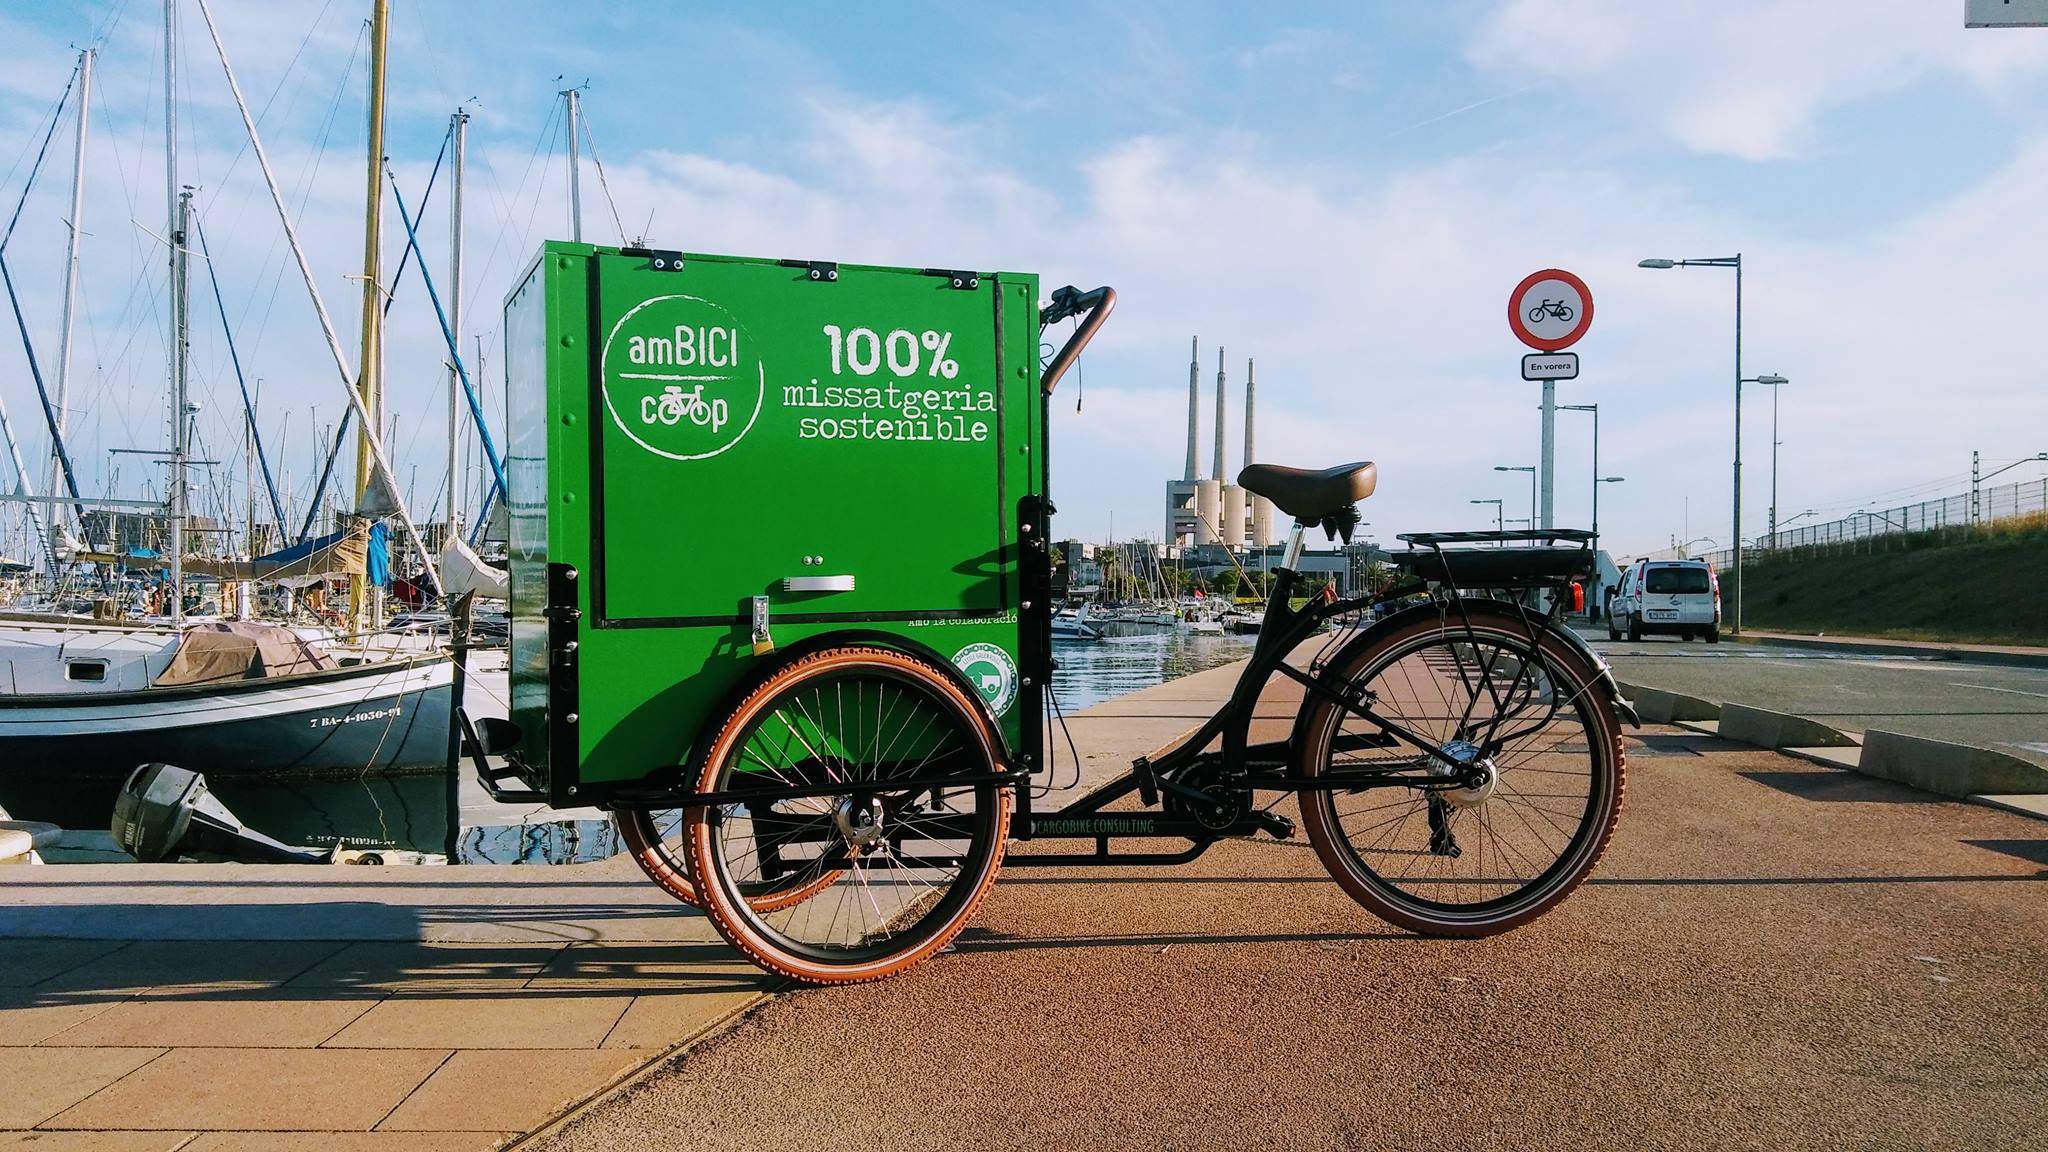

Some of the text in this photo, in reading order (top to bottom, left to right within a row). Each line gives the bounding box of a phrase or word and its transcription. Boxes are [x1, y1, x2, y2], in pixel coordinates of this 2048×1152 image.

[628, 325, 738, 367] amBICI
[823, 324, 959, 379] 100%
[1531, 363, 1542, 371] En
[783, 378, 997, 419] missatgeria
[799, 411, 988, 442] sostenible
[1036, 819, 1155, 834] CARGOBIKE CONSULTING
